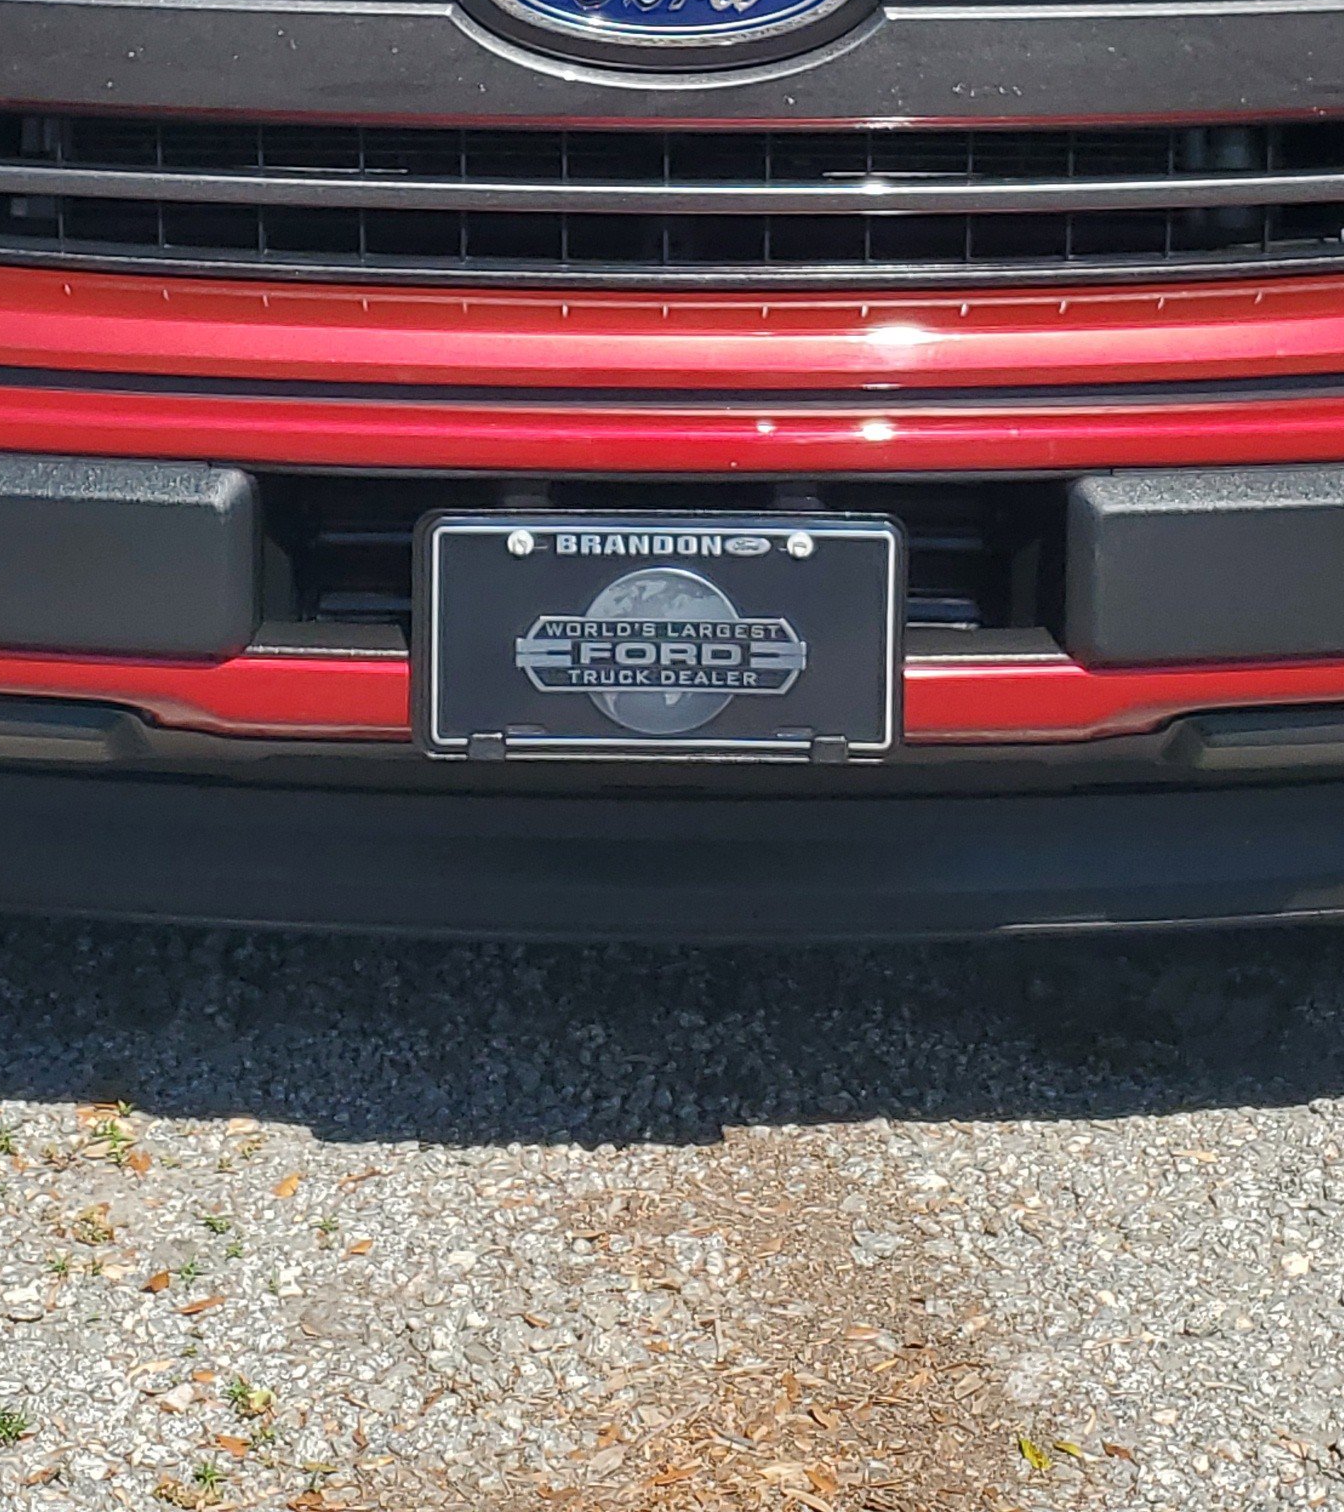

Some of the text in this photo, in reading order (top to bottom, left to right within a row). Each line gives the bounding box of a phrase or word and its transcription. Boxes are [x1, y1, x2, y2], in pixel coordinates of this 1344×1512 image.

[556, 534, 722, 556] BRANDON
[544, 621, 780, 640] WORLD'S LARGEST
[580, 642, 742, 666] FORD
[567, 669, 758, 687] TRUCK DEALER
